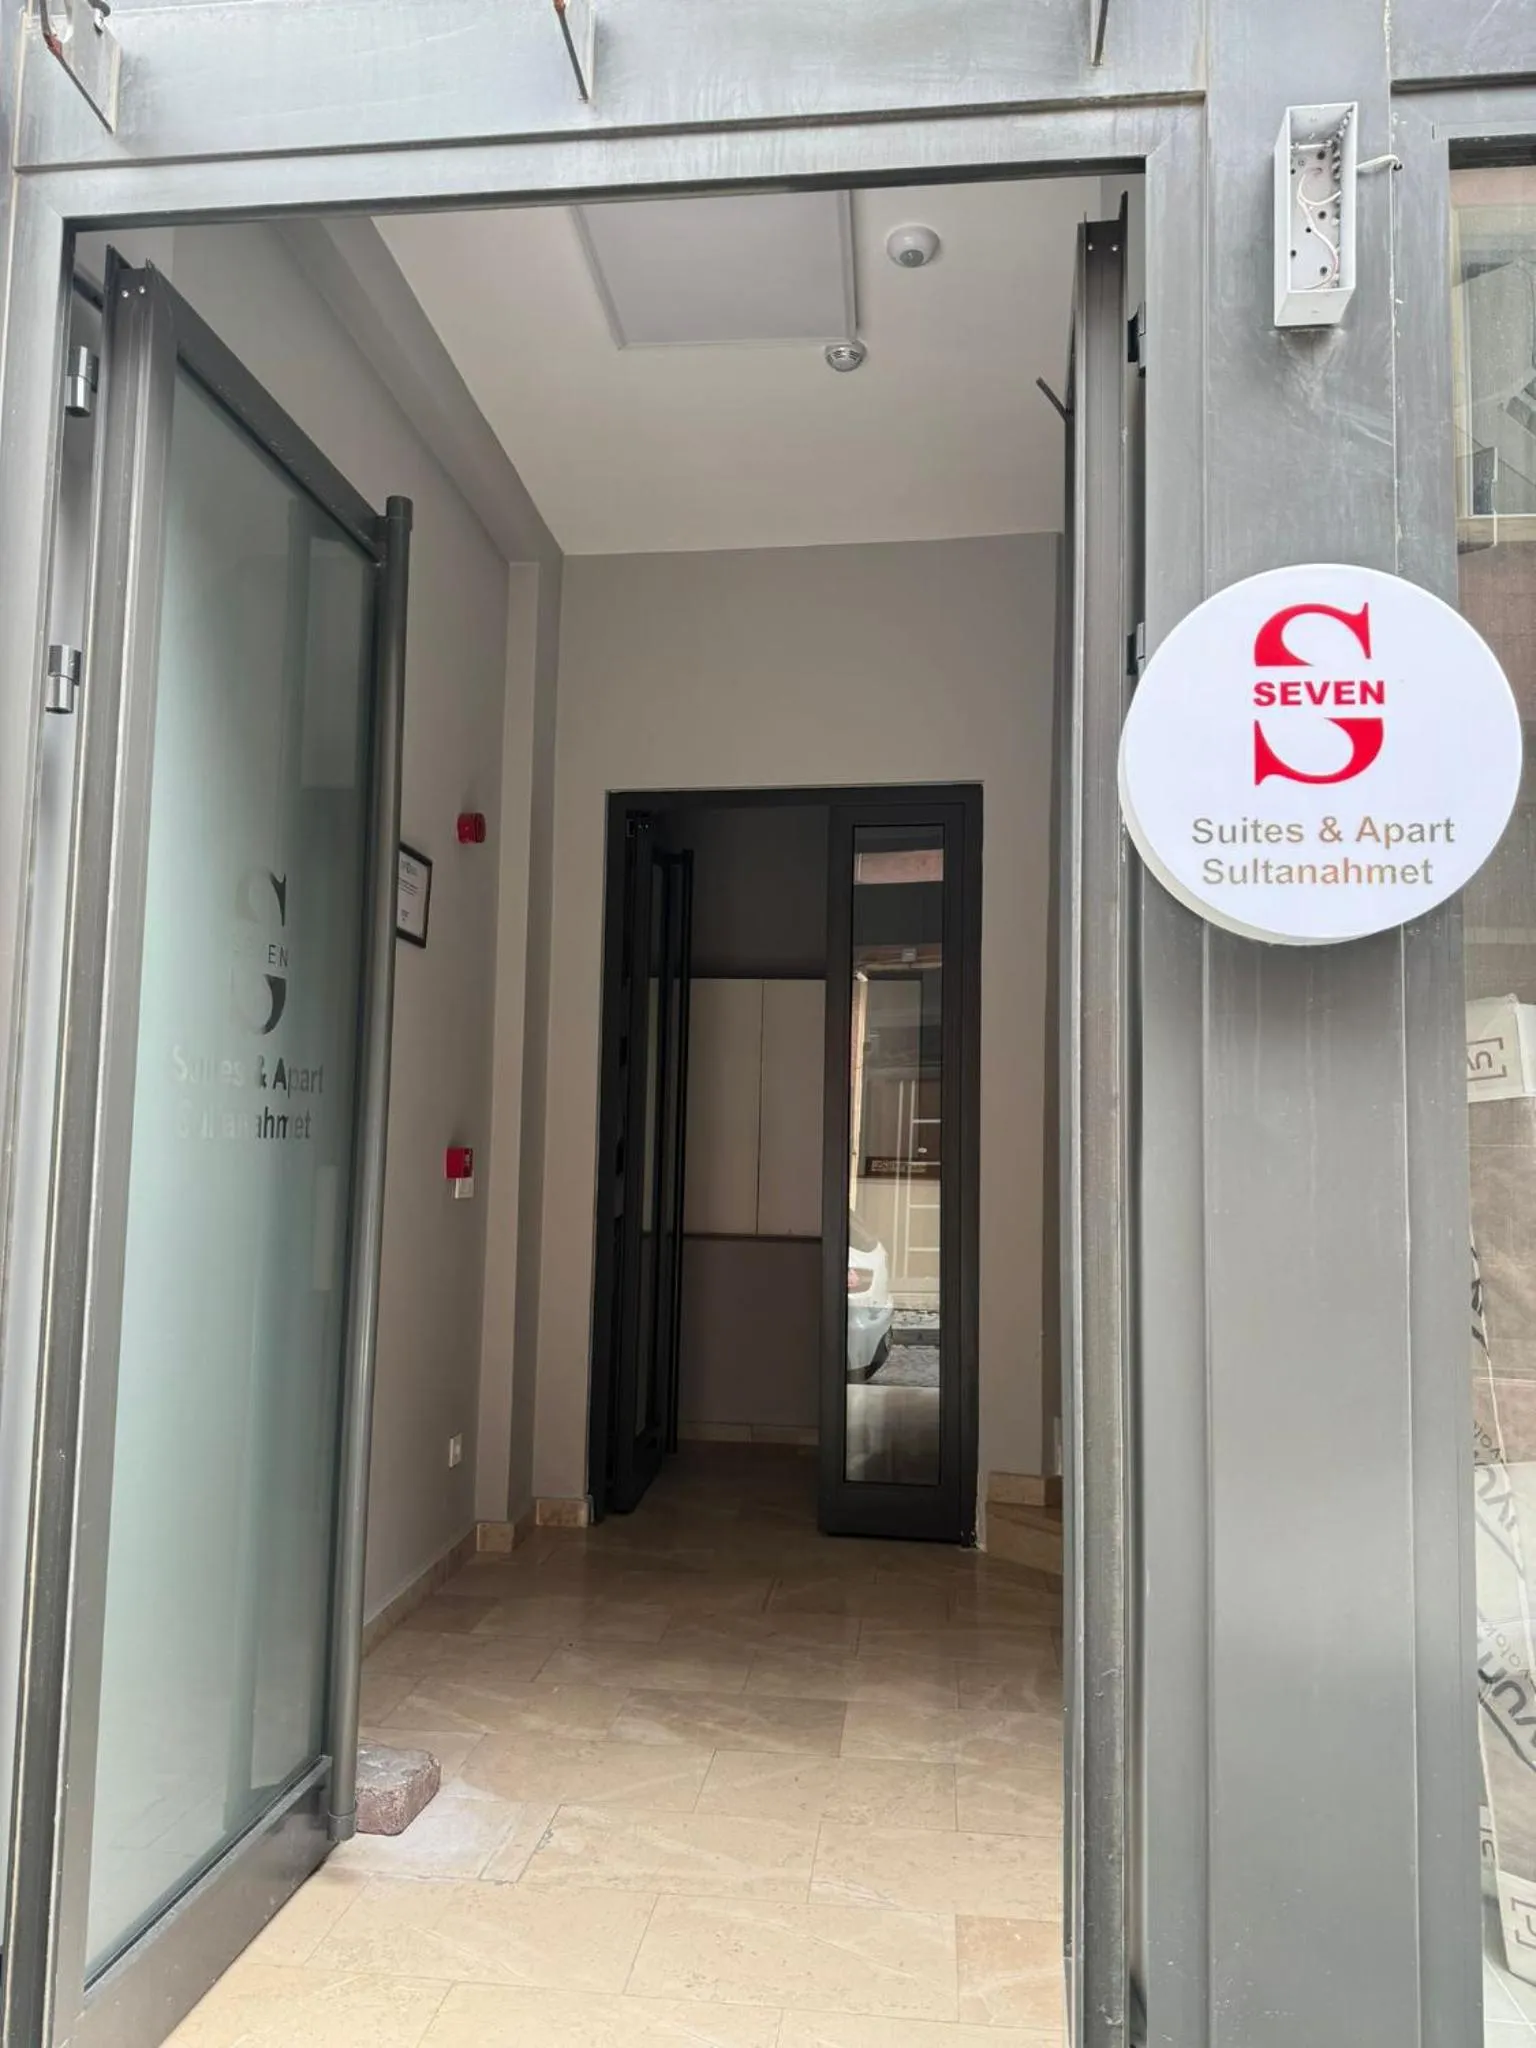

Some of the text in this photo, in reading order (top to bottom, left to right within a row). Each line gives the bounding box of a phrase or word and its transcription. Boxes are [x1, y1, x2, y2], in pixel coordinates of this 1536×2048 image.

[1253, 680, 1385, 707] SEVEN
[1192, 816, 1456, 851] Suites & Apart
[1203, 857, 1433, 886] Sultanahmet
[272, 1057, 324, 1099] Apart
